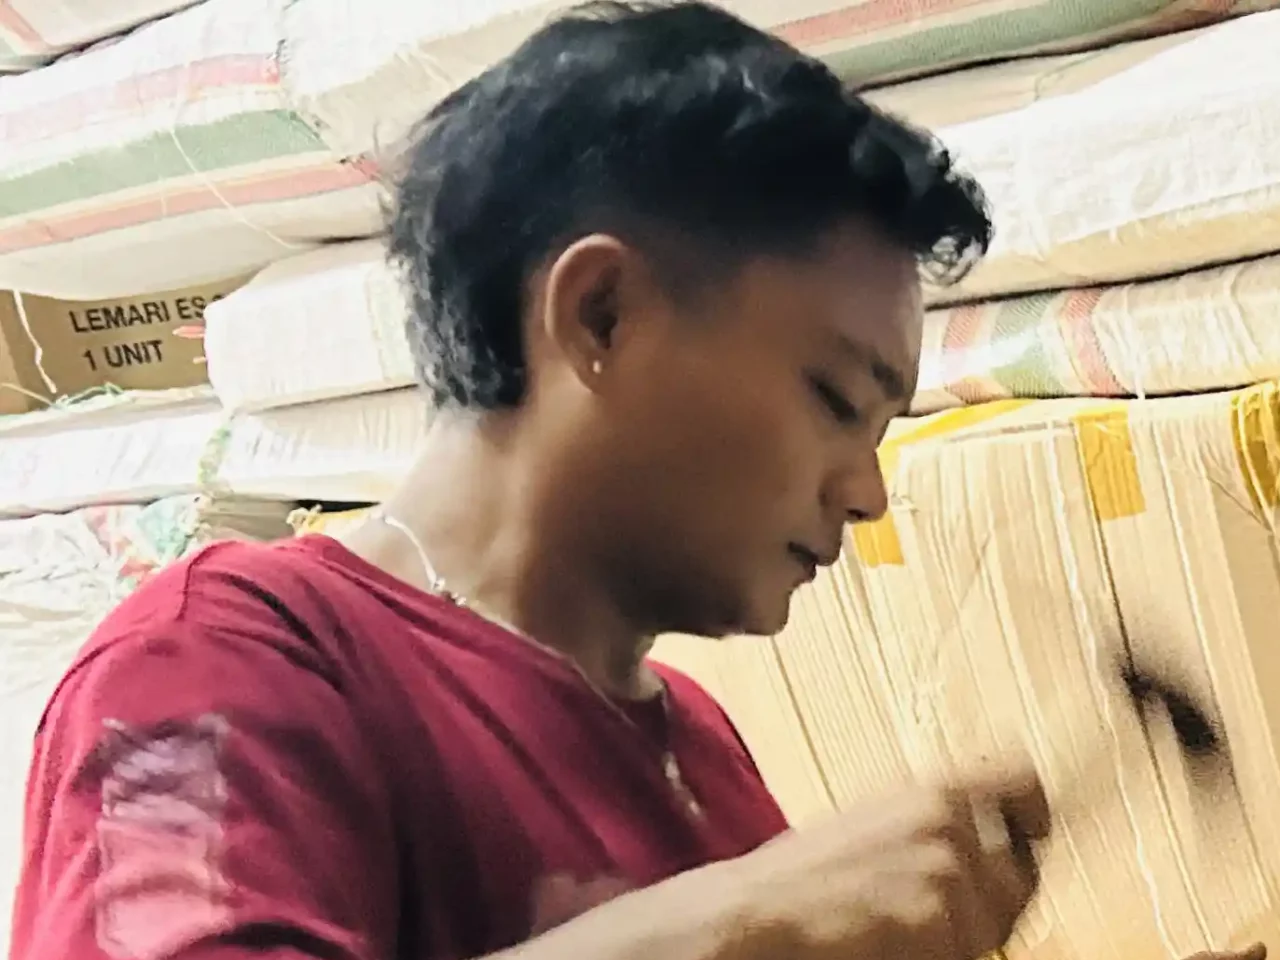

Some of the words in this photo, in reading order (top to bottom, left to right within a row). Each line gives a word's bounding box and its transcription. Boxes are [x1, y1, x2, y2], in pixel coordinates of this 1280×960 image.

[69, 300, 171, 334] LEMARI
[82, 349, 97, 371] 1
[104, 340, 163, 368] UNIT
